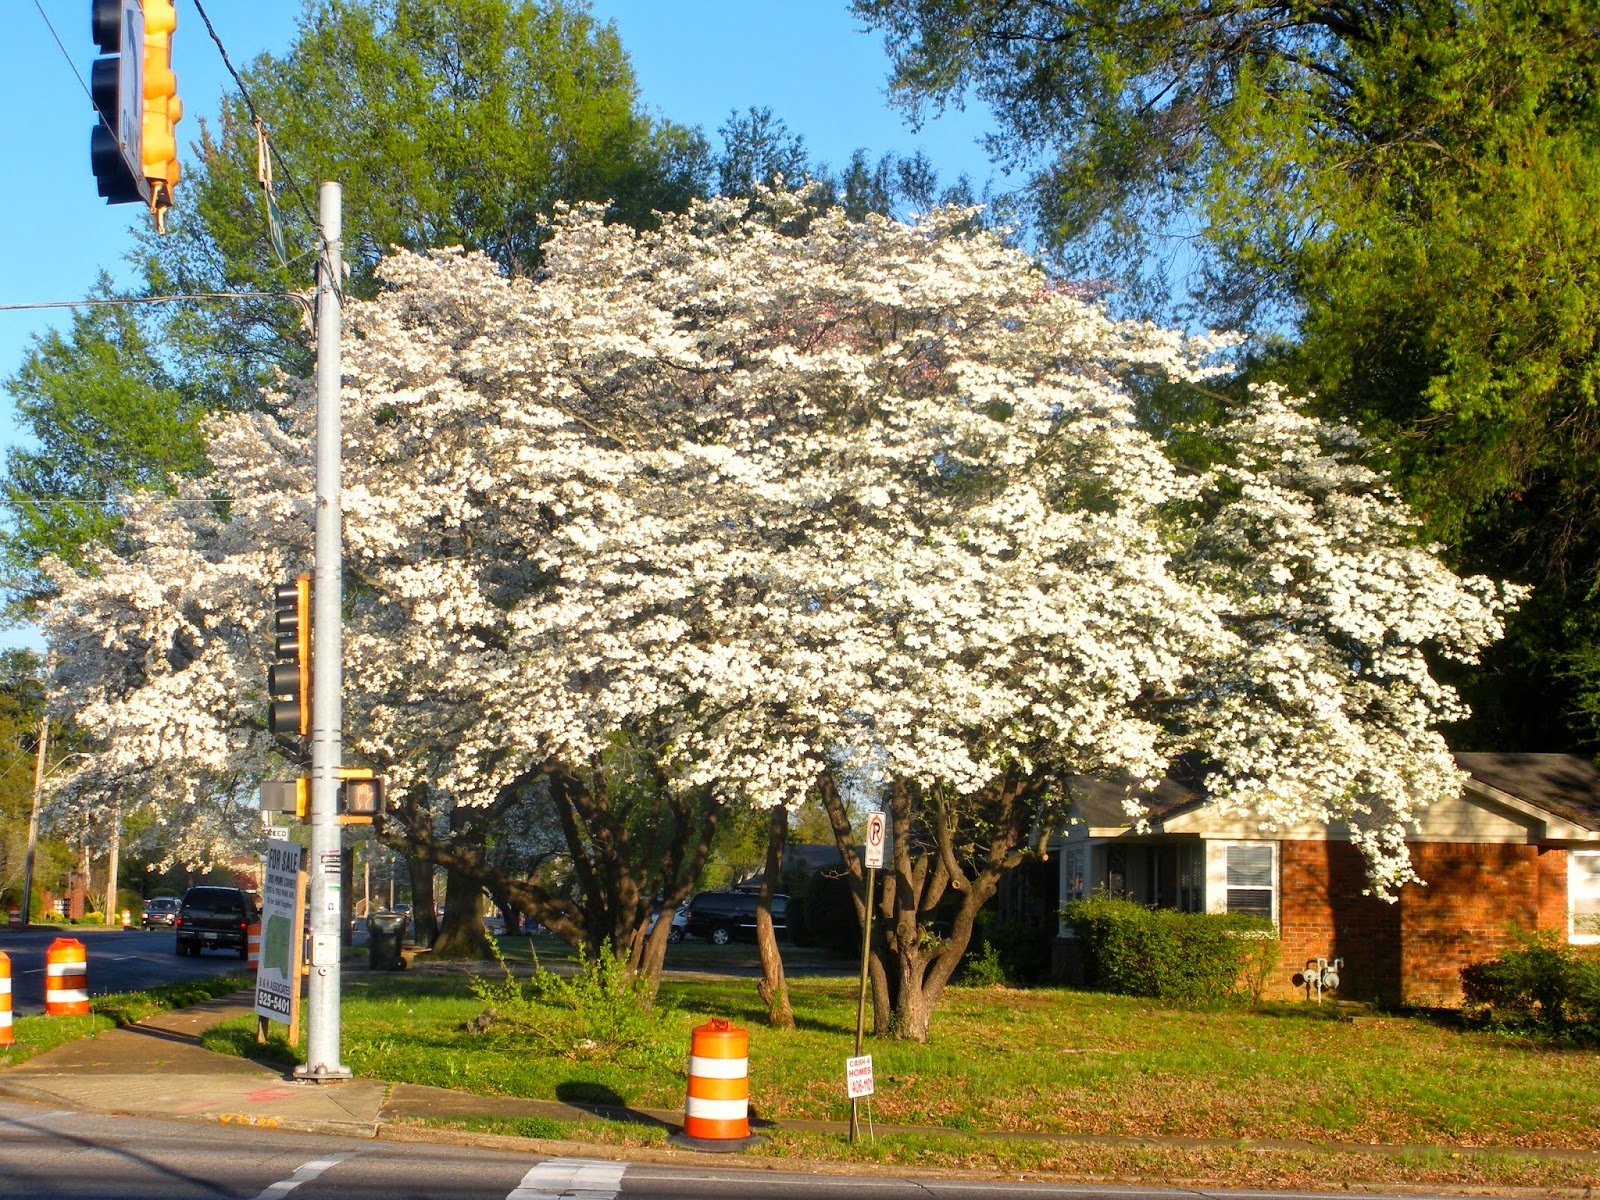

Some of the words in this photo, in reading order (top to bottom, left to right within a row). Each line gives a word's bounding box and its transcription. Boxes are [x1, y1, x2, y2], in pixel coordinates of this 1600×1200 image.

[269, 849, 281, 870] FOR
[282, 851, 297, 873] SALE
[270, 981, 290, 996] ASSOCIATES
[259, 991, 290, 1013] 525-5401
[850, 1059, 865, 1067] CASH
[849, 1067, 871, 1077] HOMES
